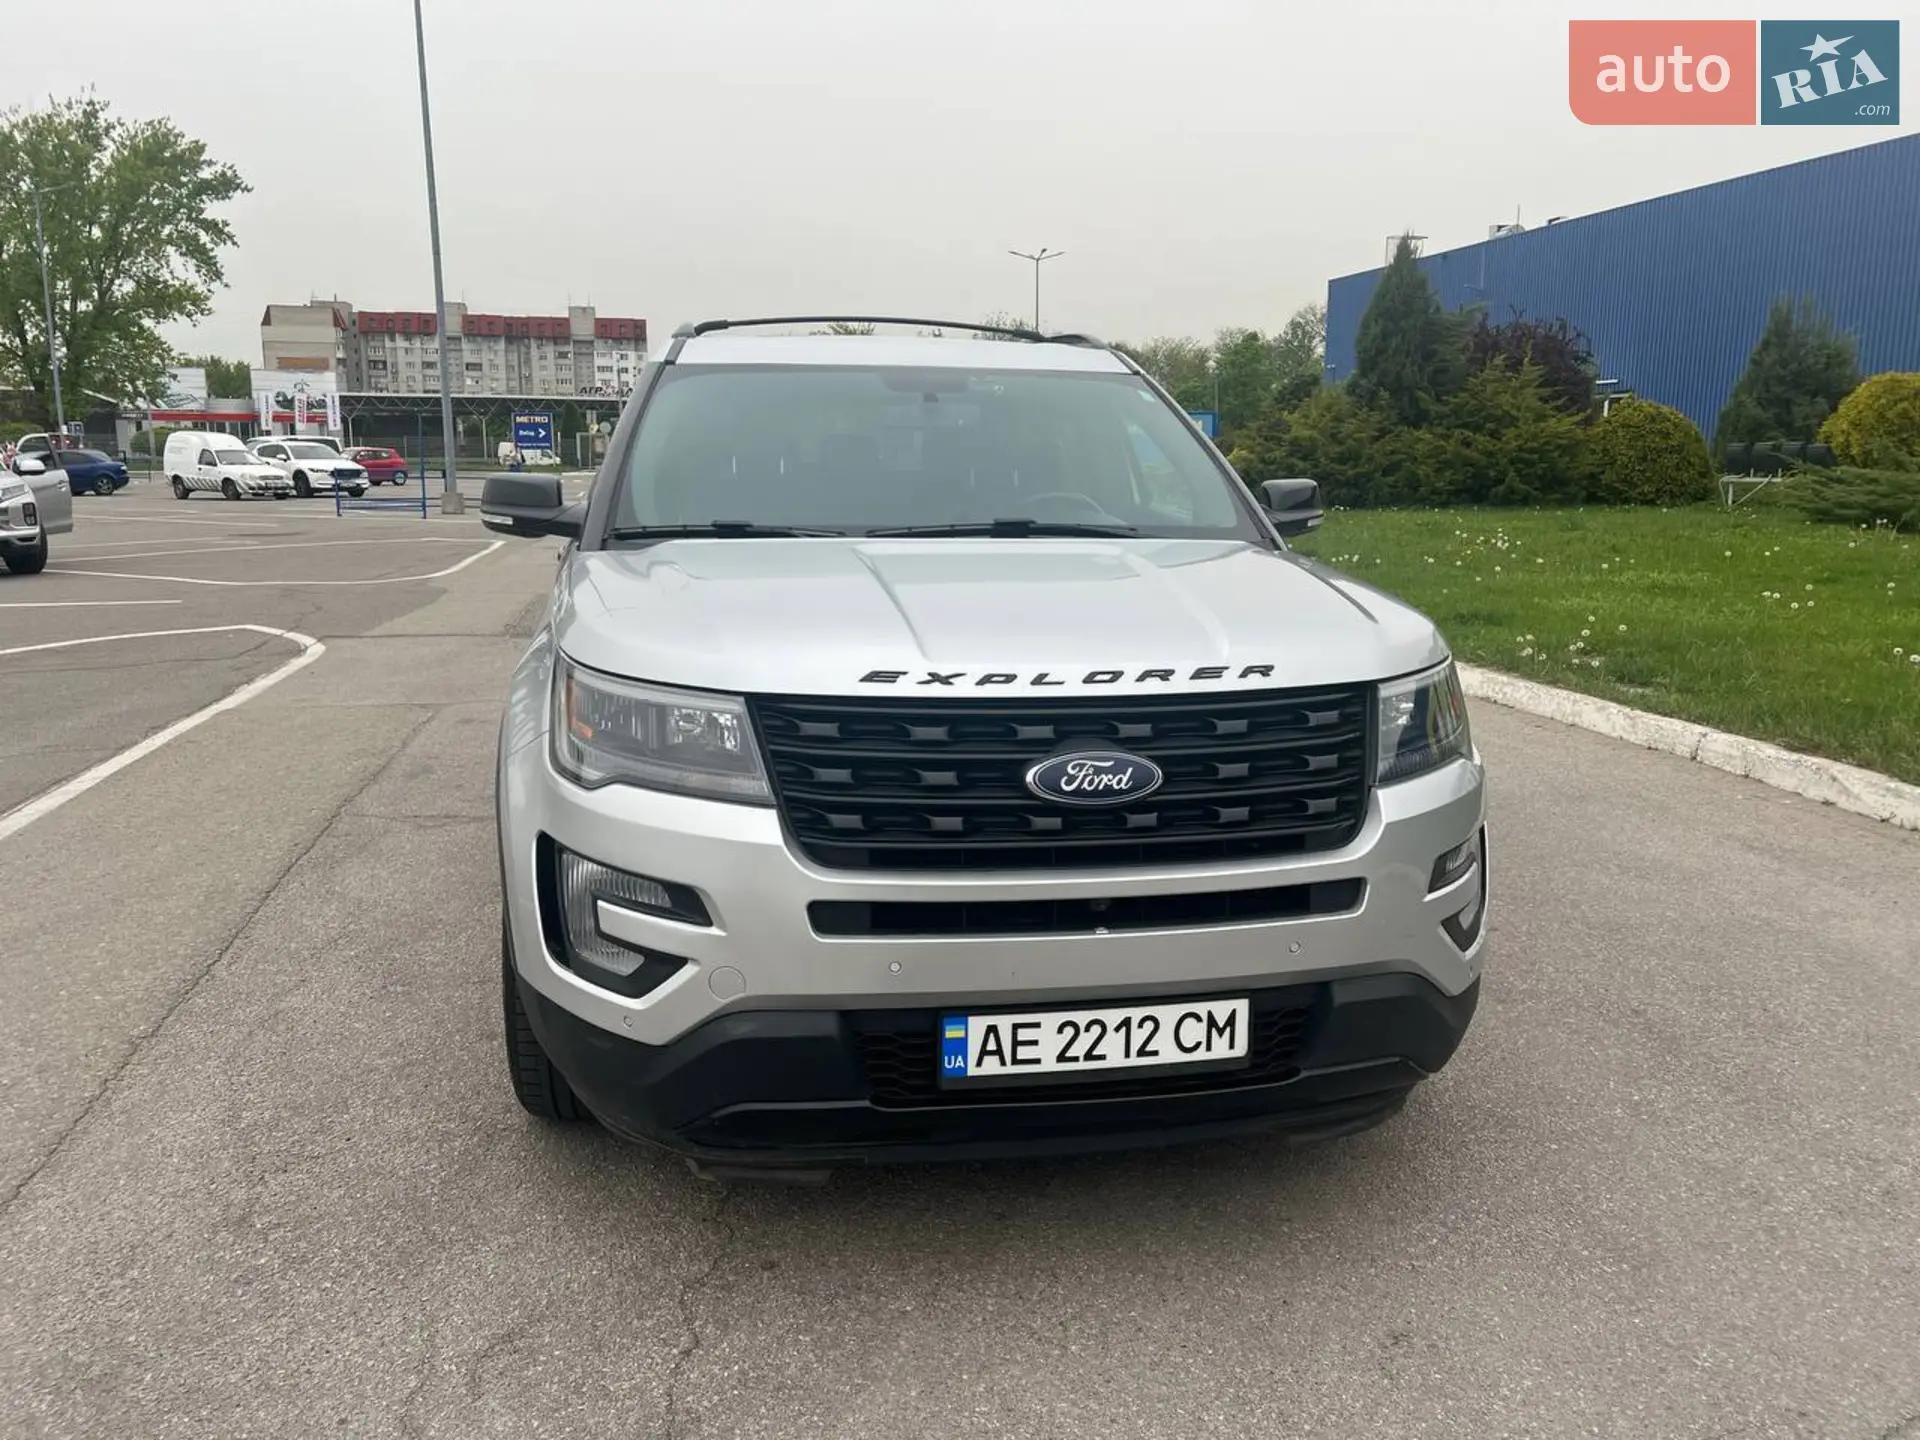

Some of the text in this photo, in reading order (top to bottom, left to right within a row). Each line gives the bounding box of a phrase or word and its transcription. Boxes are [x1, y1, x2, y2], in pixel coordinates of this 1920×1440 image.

[858, 663, 1275, 686] EXPLORER
[1060, 759, 1132, 792] Ford
[975, 1008, 1237, 1068] AE 2212 CM
[944, 1055, 965, 1069] UA
